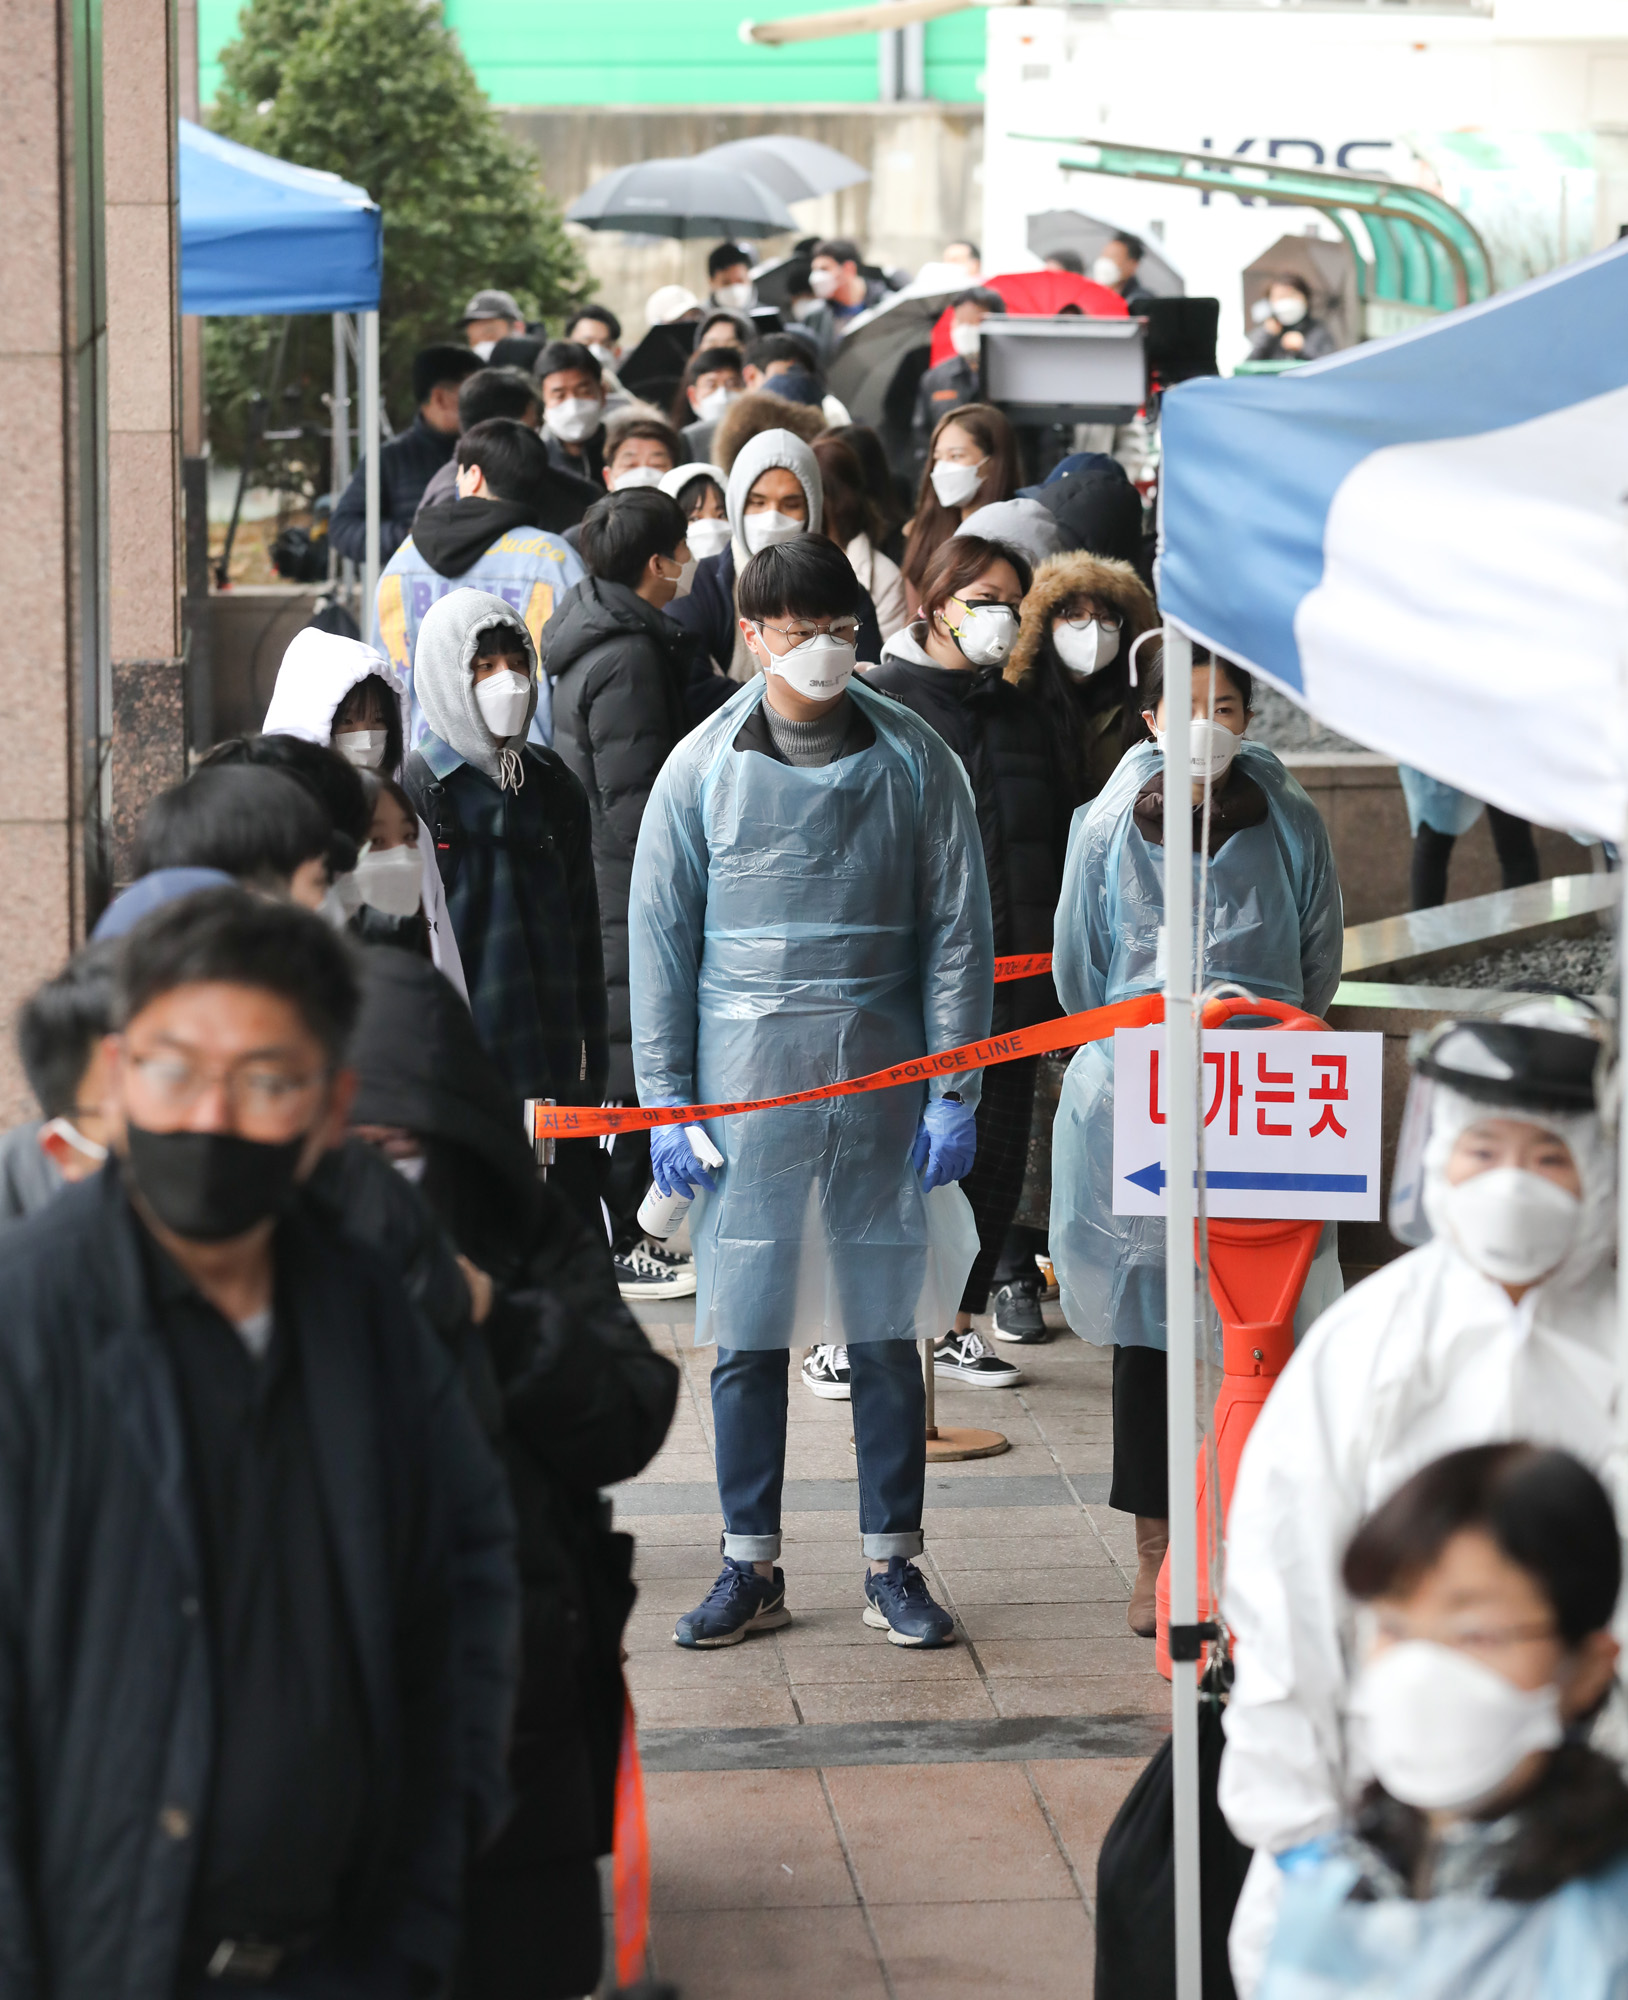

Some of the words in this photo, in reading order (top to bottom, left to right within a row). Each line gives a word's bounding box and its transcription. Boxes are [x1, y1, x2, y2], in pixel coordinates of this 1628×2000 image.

[809, 680, 824, 688] 3M
[890, 1051, 968, 1080] POLICE
[975, 1035, 1024, 1060] LINE
[642, 1110, 660, 1121] 이
